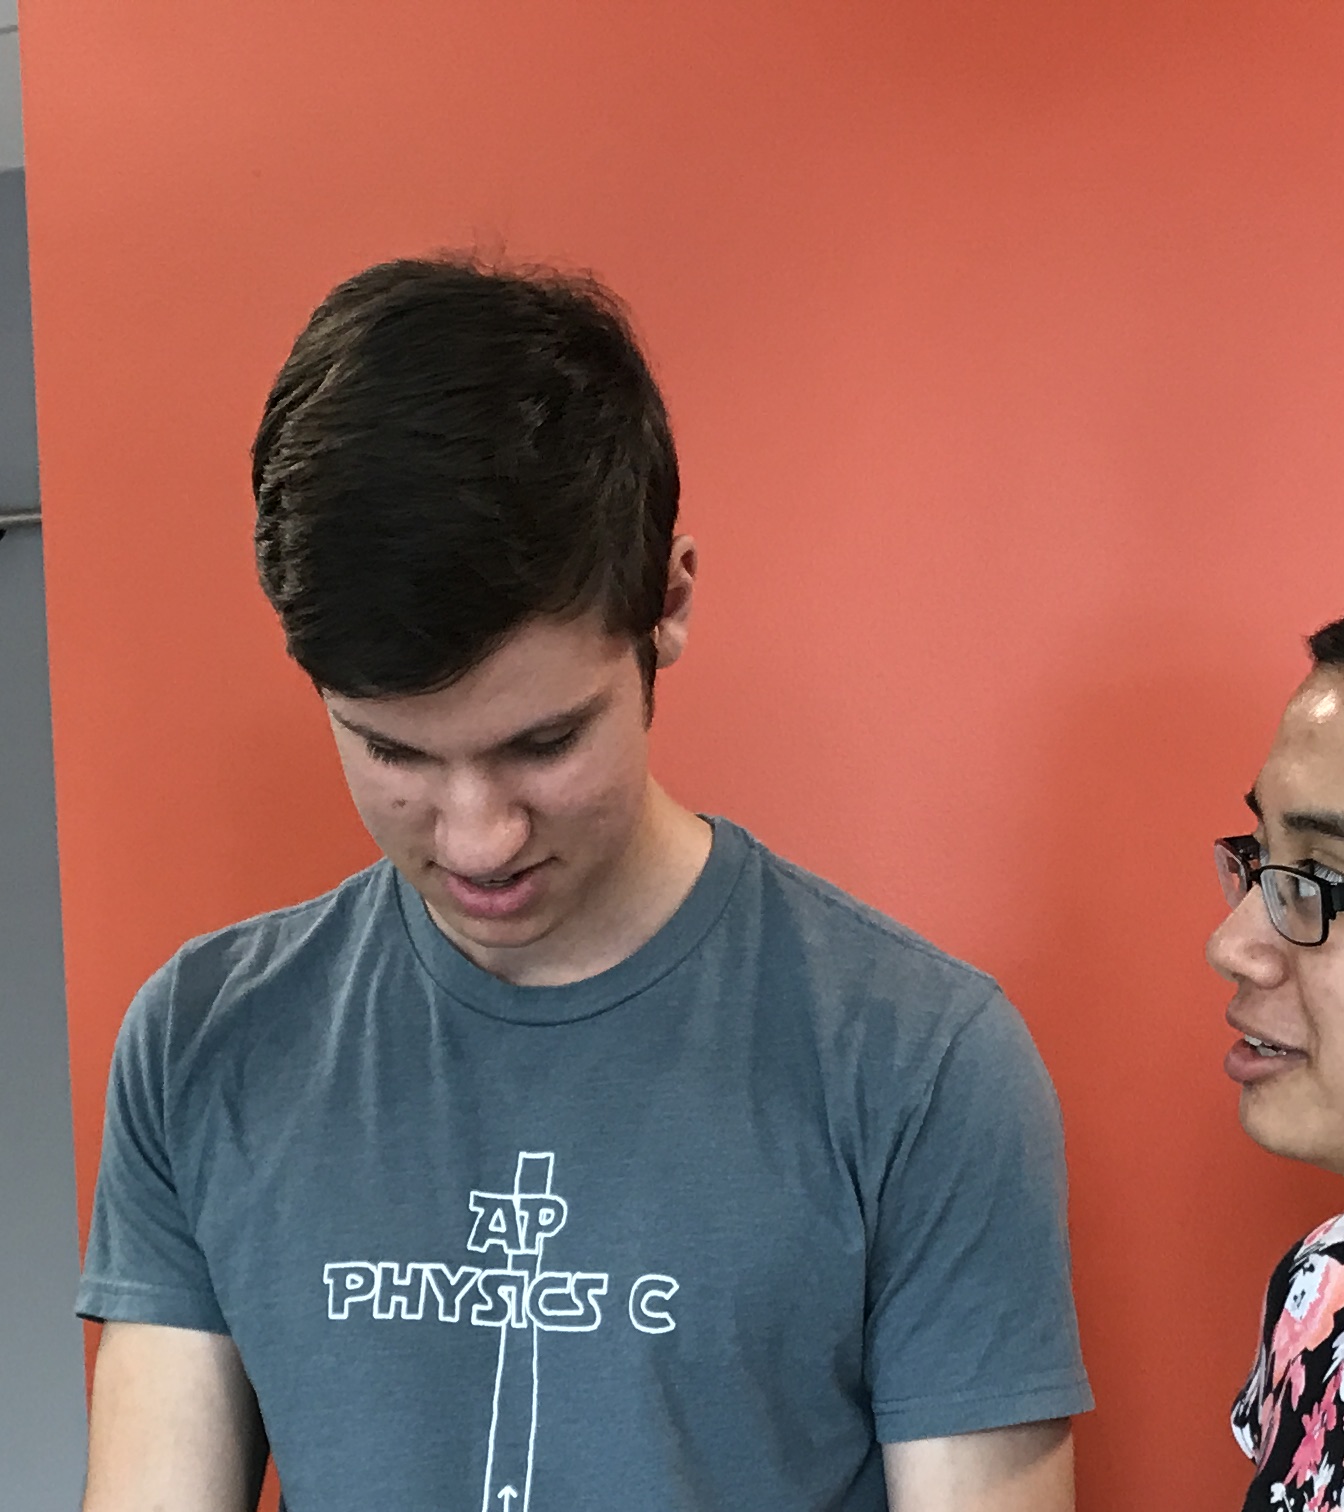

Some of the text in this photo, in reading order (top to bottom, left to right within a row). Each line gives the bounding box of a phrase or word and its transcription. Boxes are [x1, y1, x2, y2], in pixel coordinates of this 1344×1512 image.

[467, 1190, 568, 1255] AP
[323, 1261, 680, 1334] PHYSICS C
